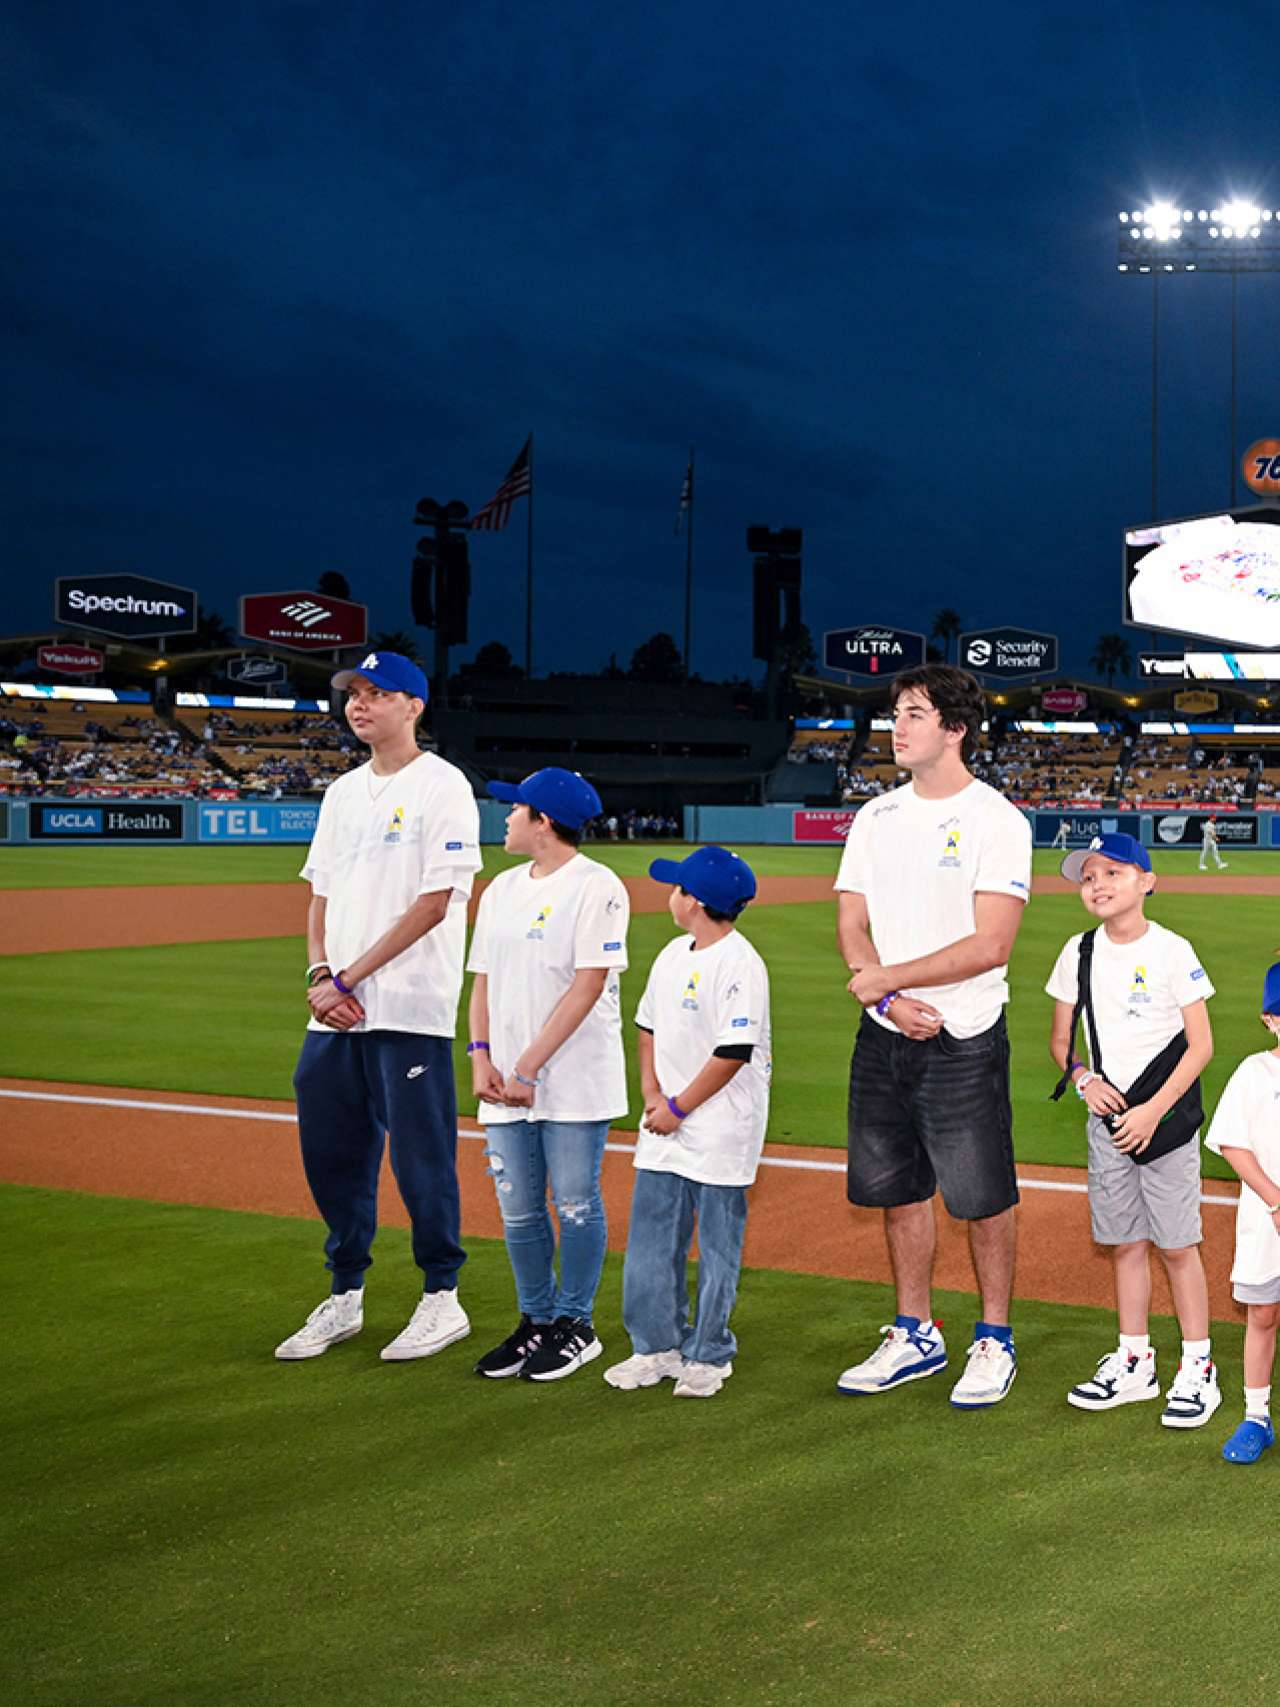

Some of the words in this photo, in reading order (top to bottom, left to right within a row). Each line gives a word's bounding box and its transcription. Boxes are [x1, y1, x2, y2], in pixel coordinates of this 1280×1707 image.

[68, 589, 178, 616] Spectrum
[305, 632, 342, 640] AMERICA
[845, 640, 903, 655] ULTRA
[996, 640, 1049, 656] Security
[997, 654, 1041, 667] Benefit
[50, 813, 96, 828] UCLA
[107, 812, 171, 831] Health
[203, 809, 268, 835] TEL
